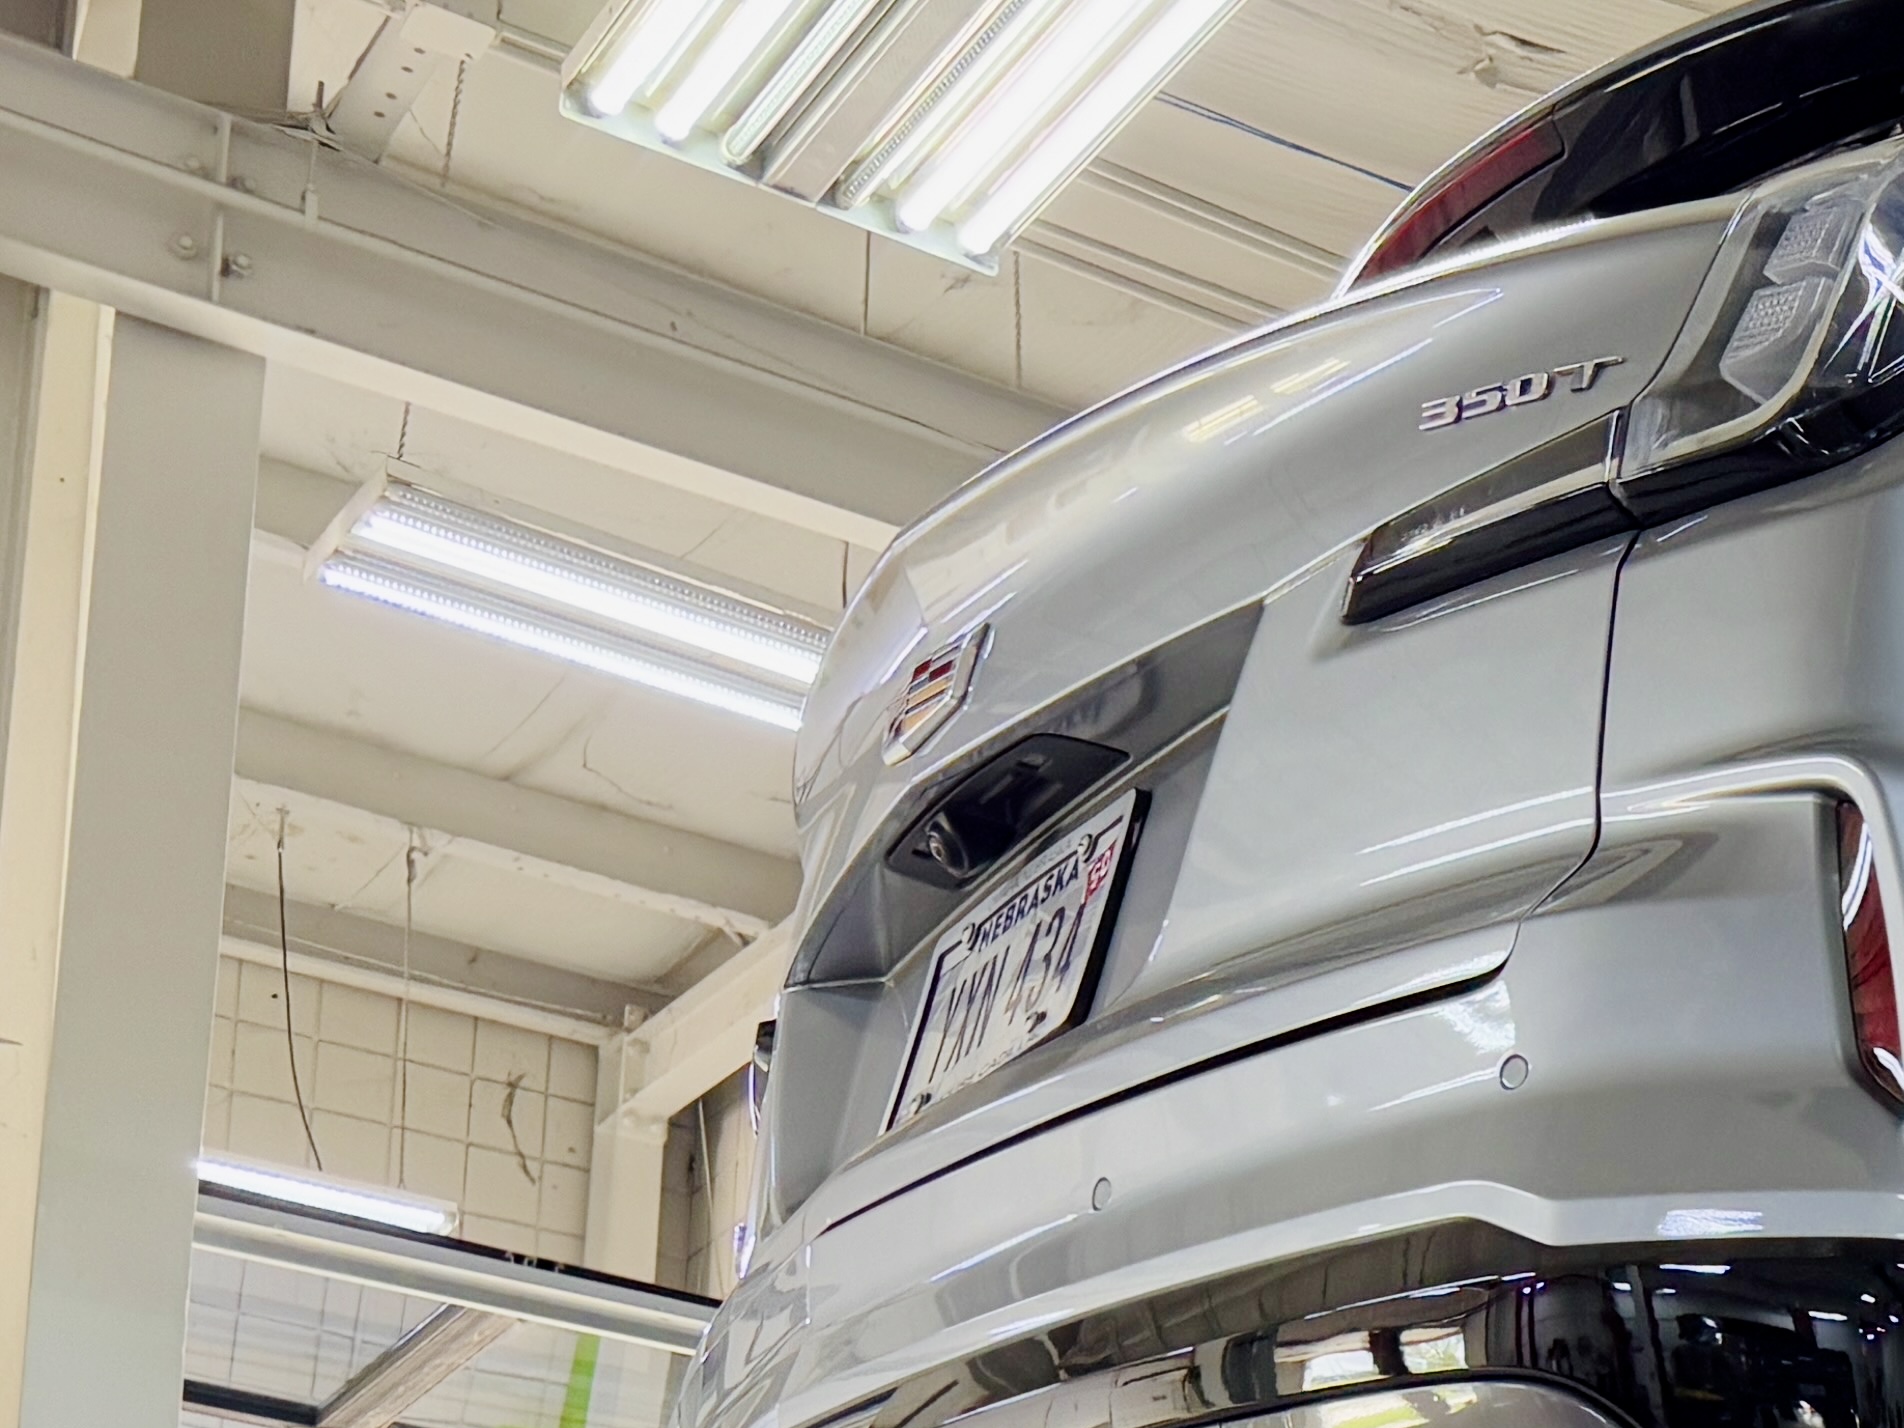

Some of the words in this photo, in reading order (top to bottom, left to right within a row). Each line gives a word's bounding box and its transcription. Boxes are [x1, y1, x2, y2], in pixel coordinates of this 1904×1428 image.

[1418, 354, 1626, 432] 350T
[979, 856, 1081, 954] NEBRASKA
[928, 943, 1011, 1086] YXN
[1003, 902, 1088, 1028] 434
